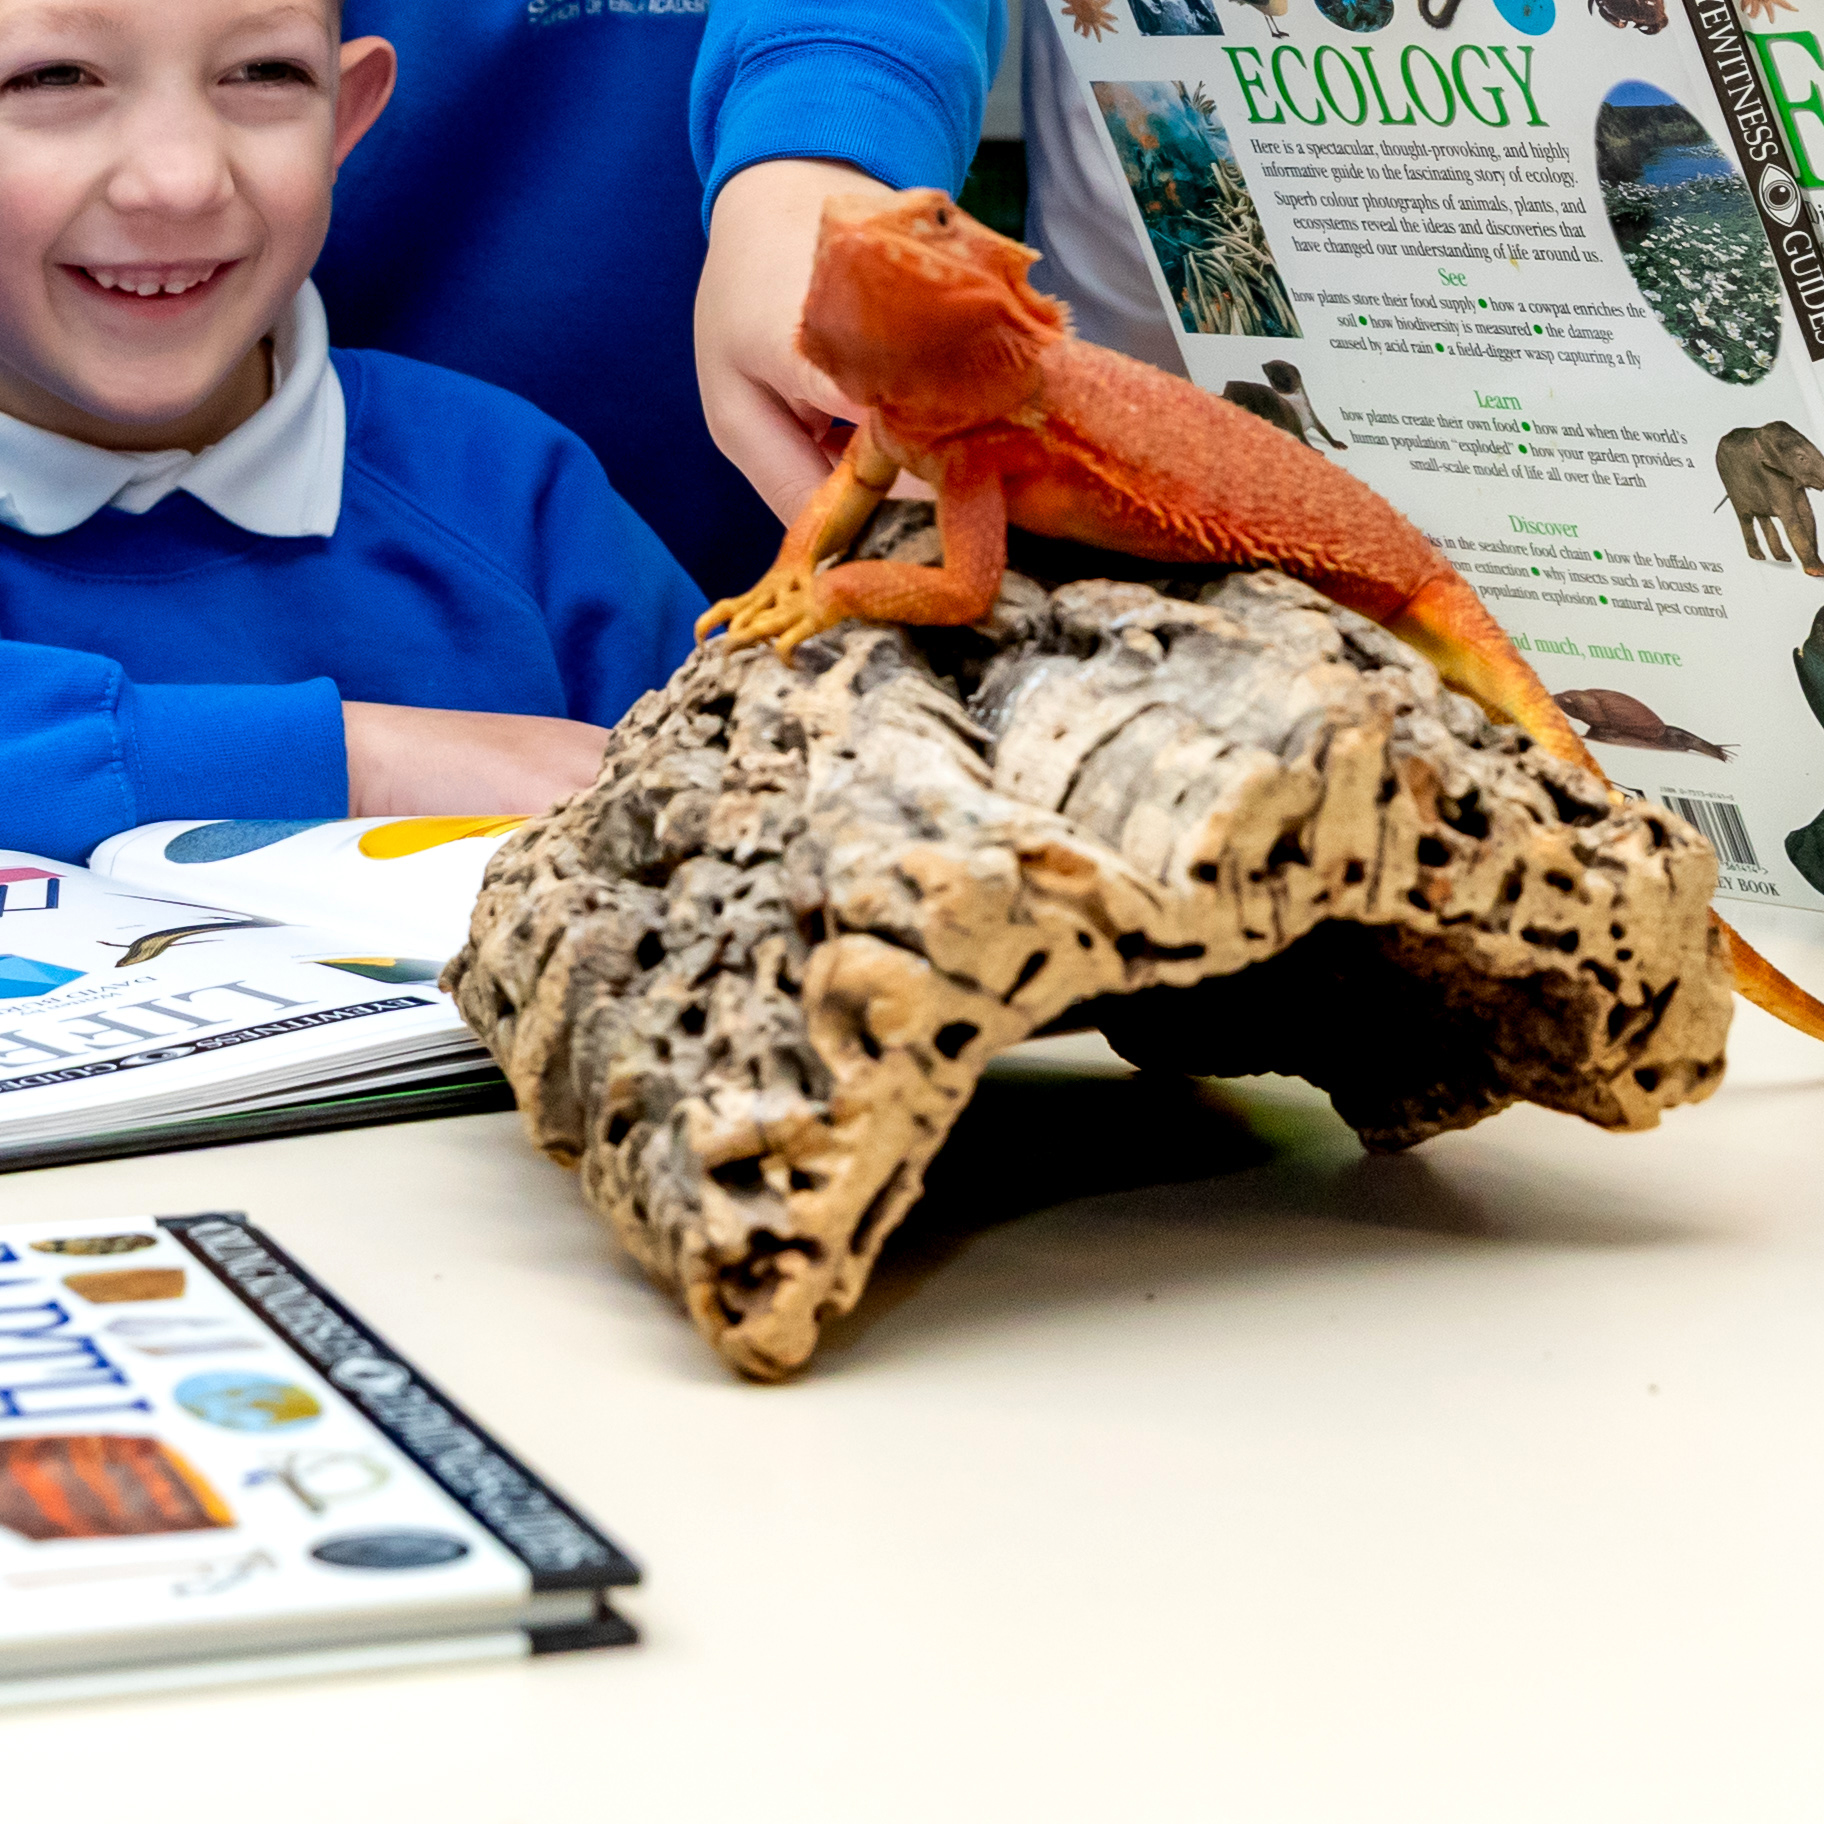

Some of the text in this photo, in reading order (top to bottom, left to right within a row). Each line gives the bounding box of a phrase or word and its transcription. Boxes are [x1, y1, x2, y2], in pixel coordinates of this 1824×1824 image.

[1222, 45, 1549, 127] ECOLOGY
[1249, 138, 1571, 164] Here is a spectacular, thought-provoking, and highly
[1261, 160, 1579, 189] informative guide to the fascinating story of ecology.
[1273, 190, 1588, 217] Superb colour photographs of animals, plants, and
[1292, 216, 1587, 238] ecosystems reveal the ideas and discoveries that
[1290, 235, 1604, 264] have changed our understanding of life around us.
[1437, 267, 1468, 287] See
[1291, 288, 1647, 319] how plants store their food supply how a cowpat enriches the
[1336, 312, 1615, 344] soil how biodiversity is measured the damage
[1329, 336, 1641, 368] caused by acid rain a field-digger wasp capturing a fly
[1473, 389, 1523, 412] Learn
[1338, 406, 1688, 445] how plants create their own food how and when the world's
[1348, 429, 1390, 446] human
[1390, 434, 1451, 452] population
[1528, 442, 1555, 458] how
[1556, 448, 1584, 461] your
[1586, 447, 1630, 465] garden
[1630, 451, 1684, 469] provides
[1685, 457, 1696, 469] a
[1508, 514, 1580, 538] Discover
[1535, 636, 1682, 667] much, much more
[1737, 878, 1780, 897] BOOK
[67, 976, 157, 1001] DAVID
[195, 997, 418, 1049] EYEWITNESS
